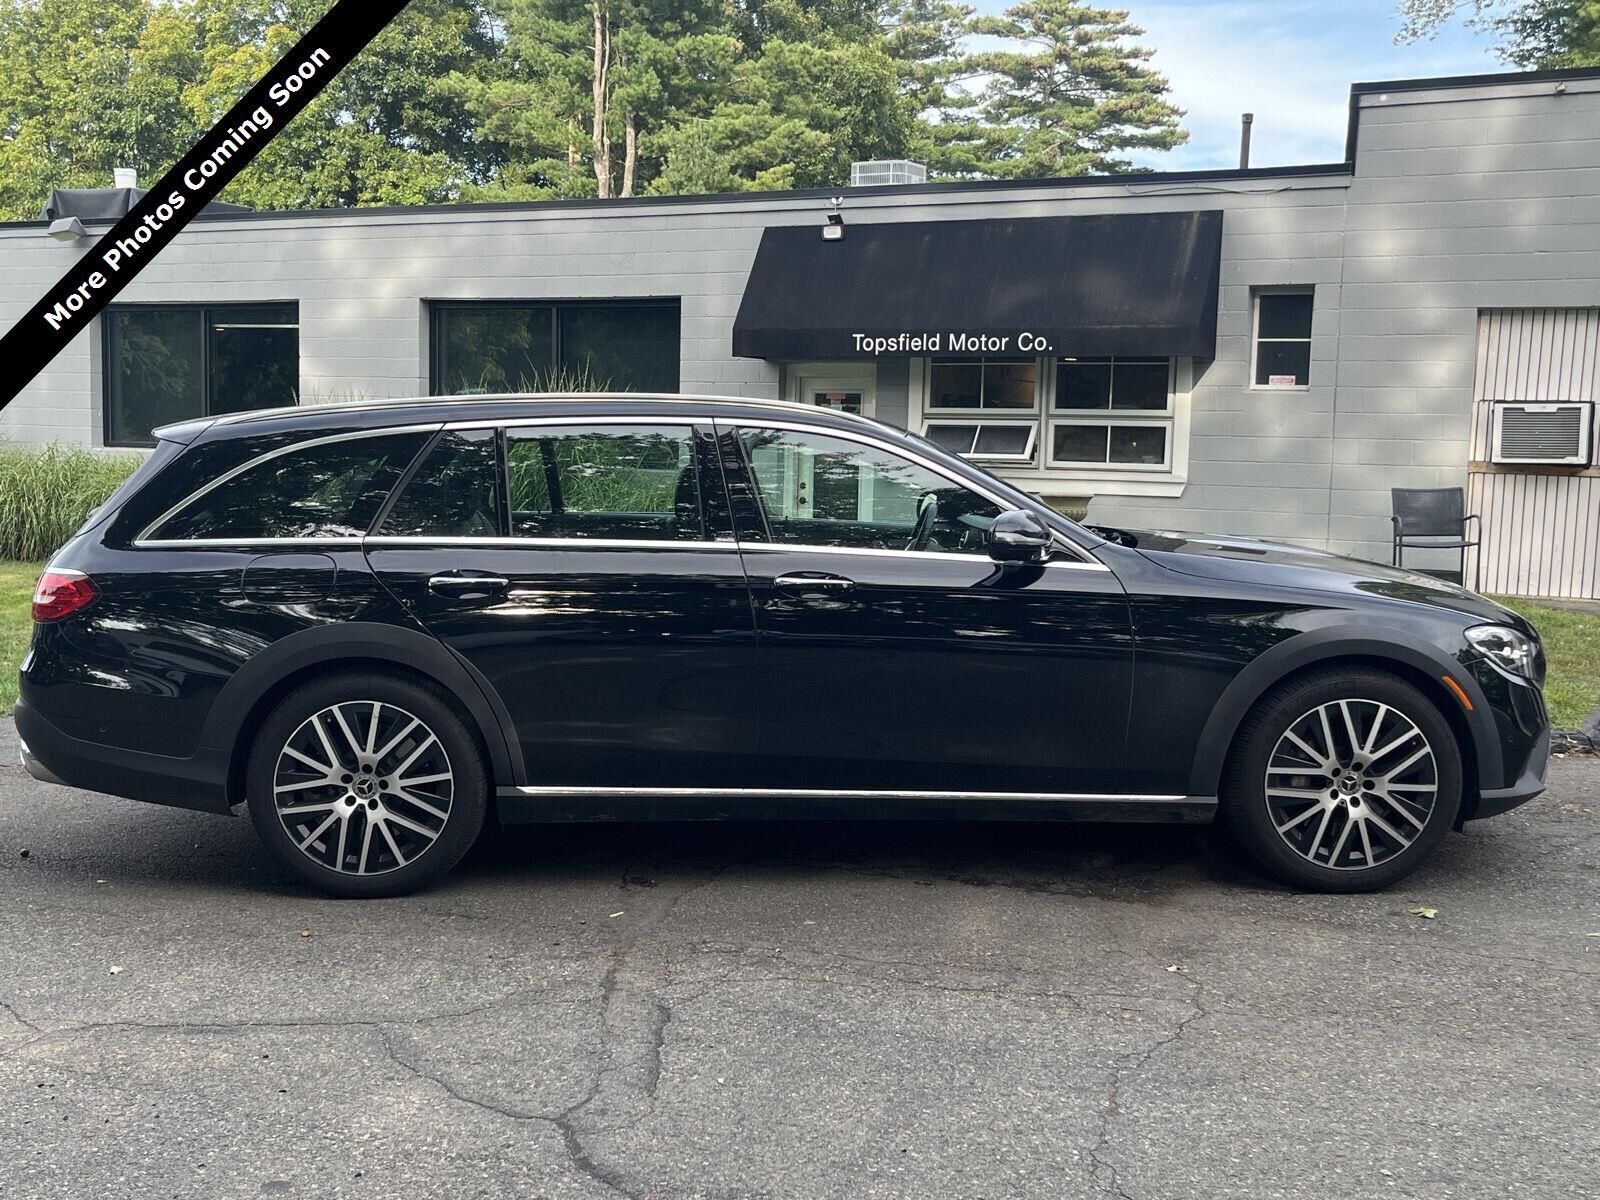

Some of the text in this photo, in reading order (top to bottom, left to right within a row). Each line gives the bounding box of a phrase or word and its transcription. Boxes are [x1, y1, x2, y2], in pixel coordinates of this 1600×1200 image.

[852, 332, 1053, 355] Topsfield Motor Co.
